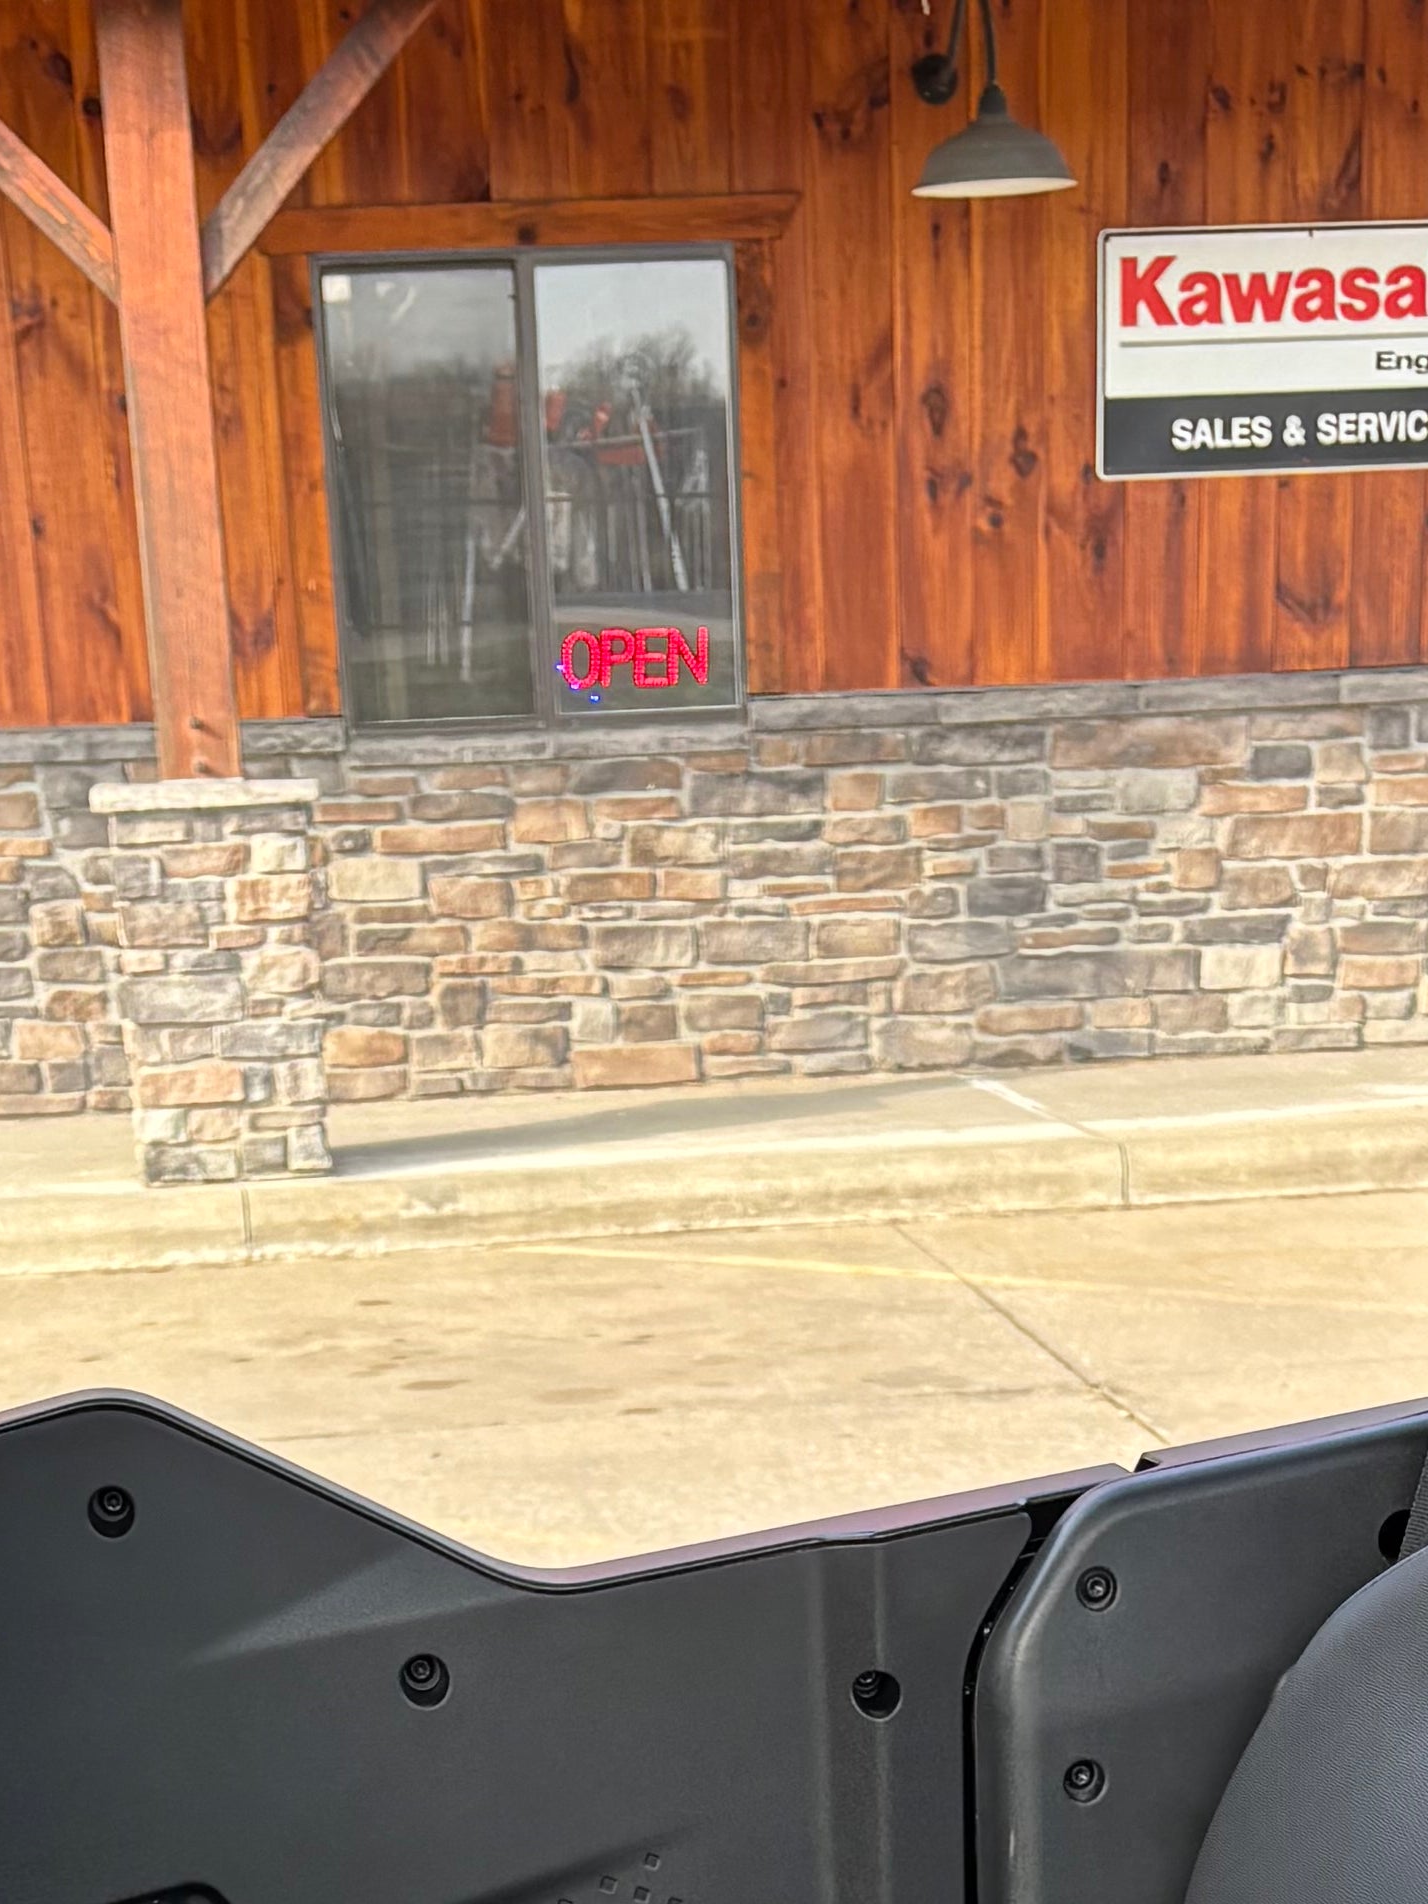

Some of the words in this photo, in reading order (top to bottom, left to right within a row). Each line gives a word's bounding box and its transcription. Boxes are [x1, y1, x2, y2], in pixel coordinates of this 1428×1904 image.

[1172, 415, 1272, 450] SALES
[1283, 414, 1306, 447] &
[561, 626, 709, 689] OPEN
